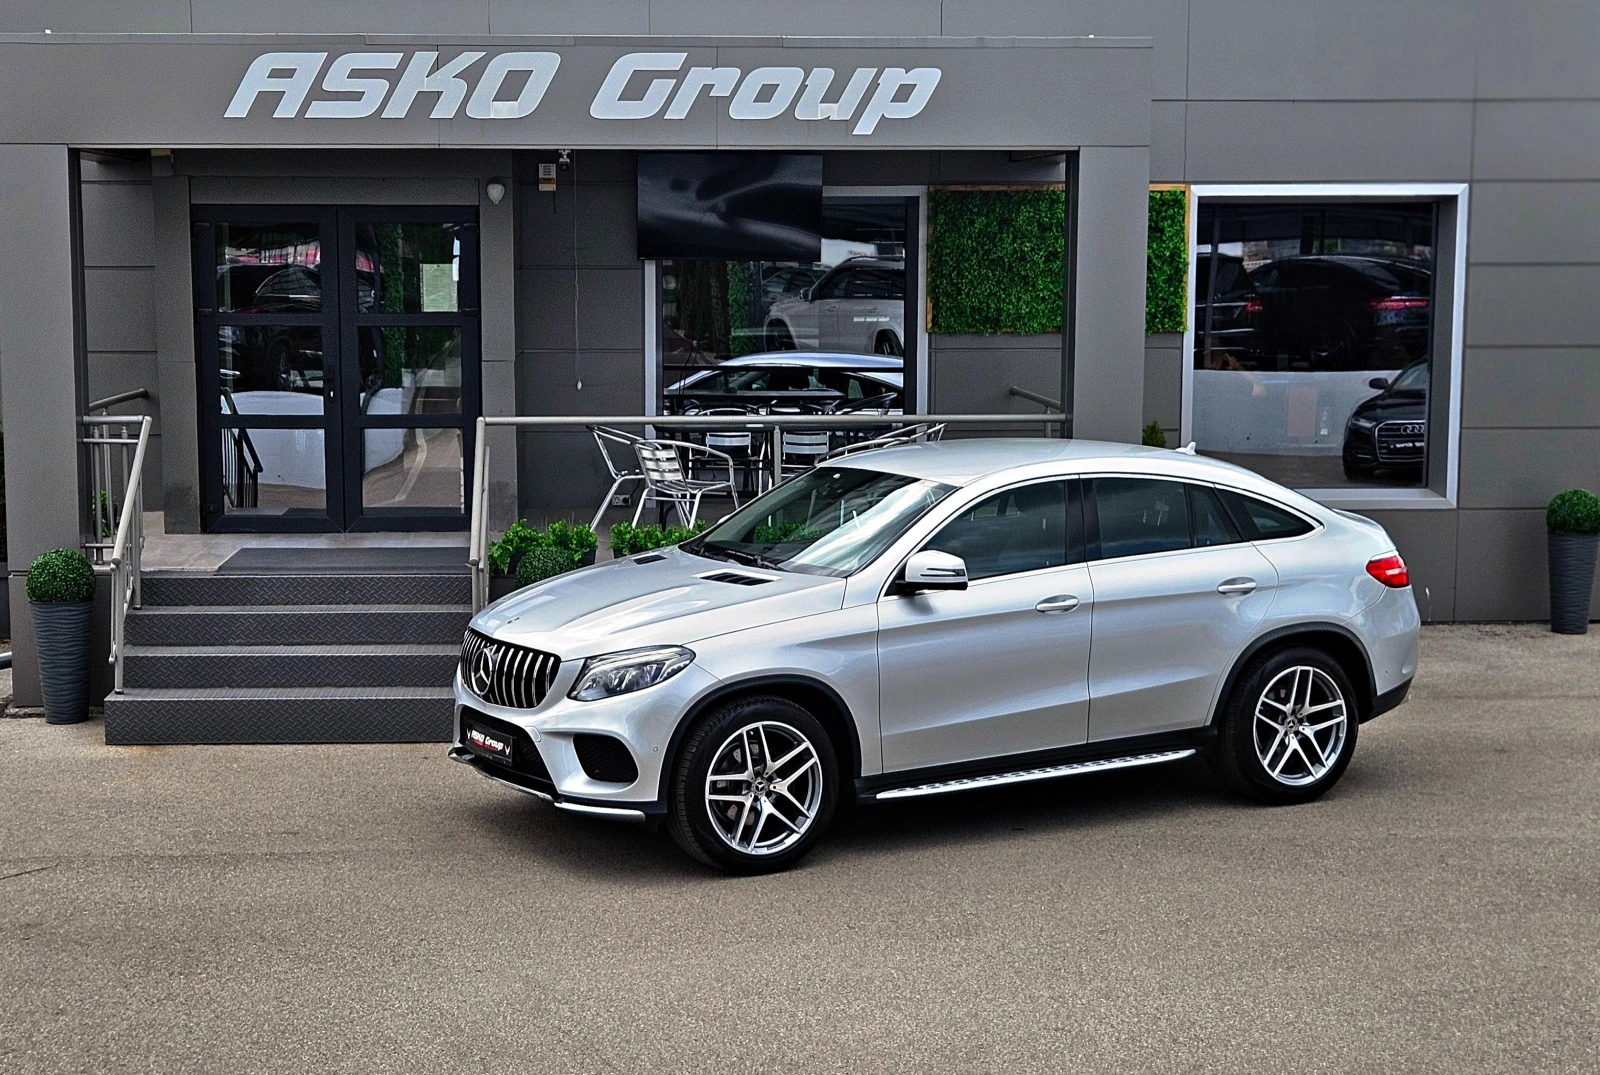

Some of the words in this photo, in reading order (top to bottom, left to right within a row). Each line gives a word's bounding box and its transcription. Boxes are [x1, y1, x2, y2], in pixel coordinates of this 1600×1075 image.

[223, 51, 561, 119] ASKO
[589, 52, 942, 135] Group
[484, 736, 504, 751] Group
